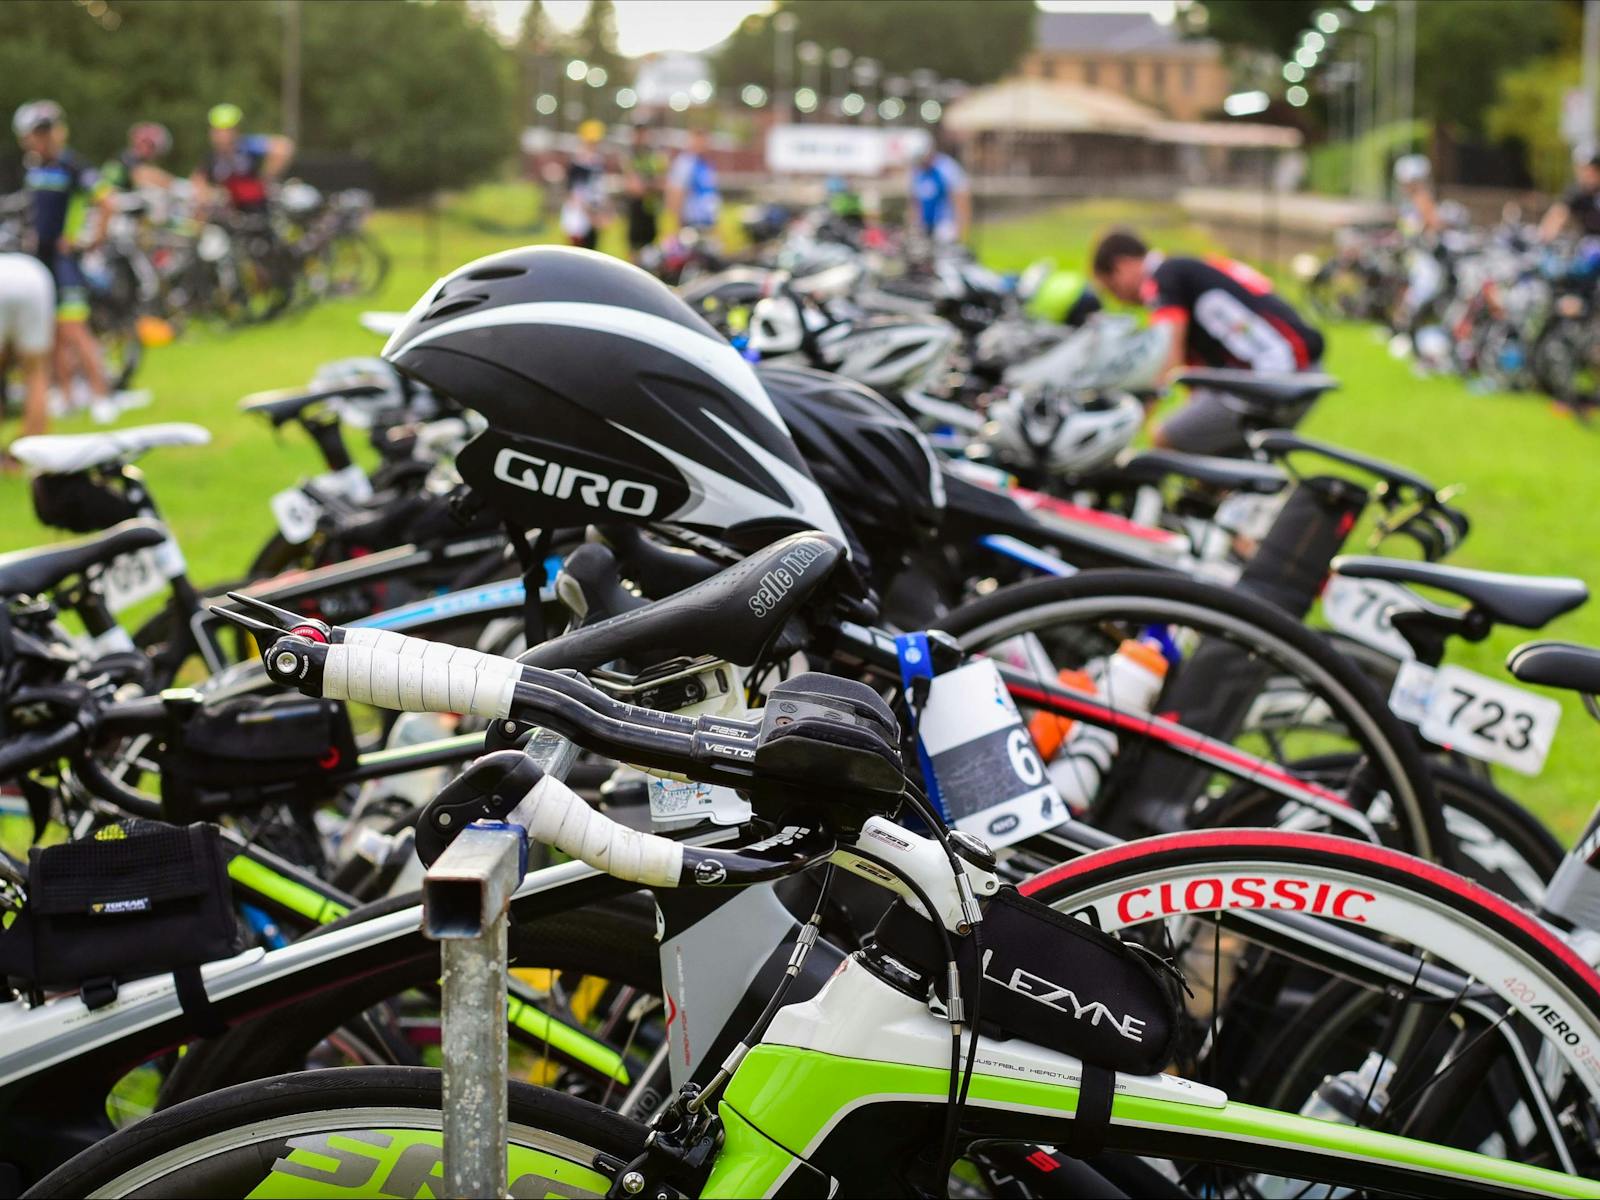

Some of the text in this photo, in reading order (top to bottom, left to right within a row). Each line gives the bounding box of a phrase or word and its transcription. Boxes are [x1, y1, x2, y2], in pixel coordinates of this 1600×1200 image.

[493, 447, 658, 517] GIRO
[748, 567, 794, 618] selle
[1449, 686, 1535, 751] 723
[981, 948, 1147, 1043] LEZYNE
[1503, 977, 1536, 1003] 420
[1530, 1003, 1581, 1046] AERO
